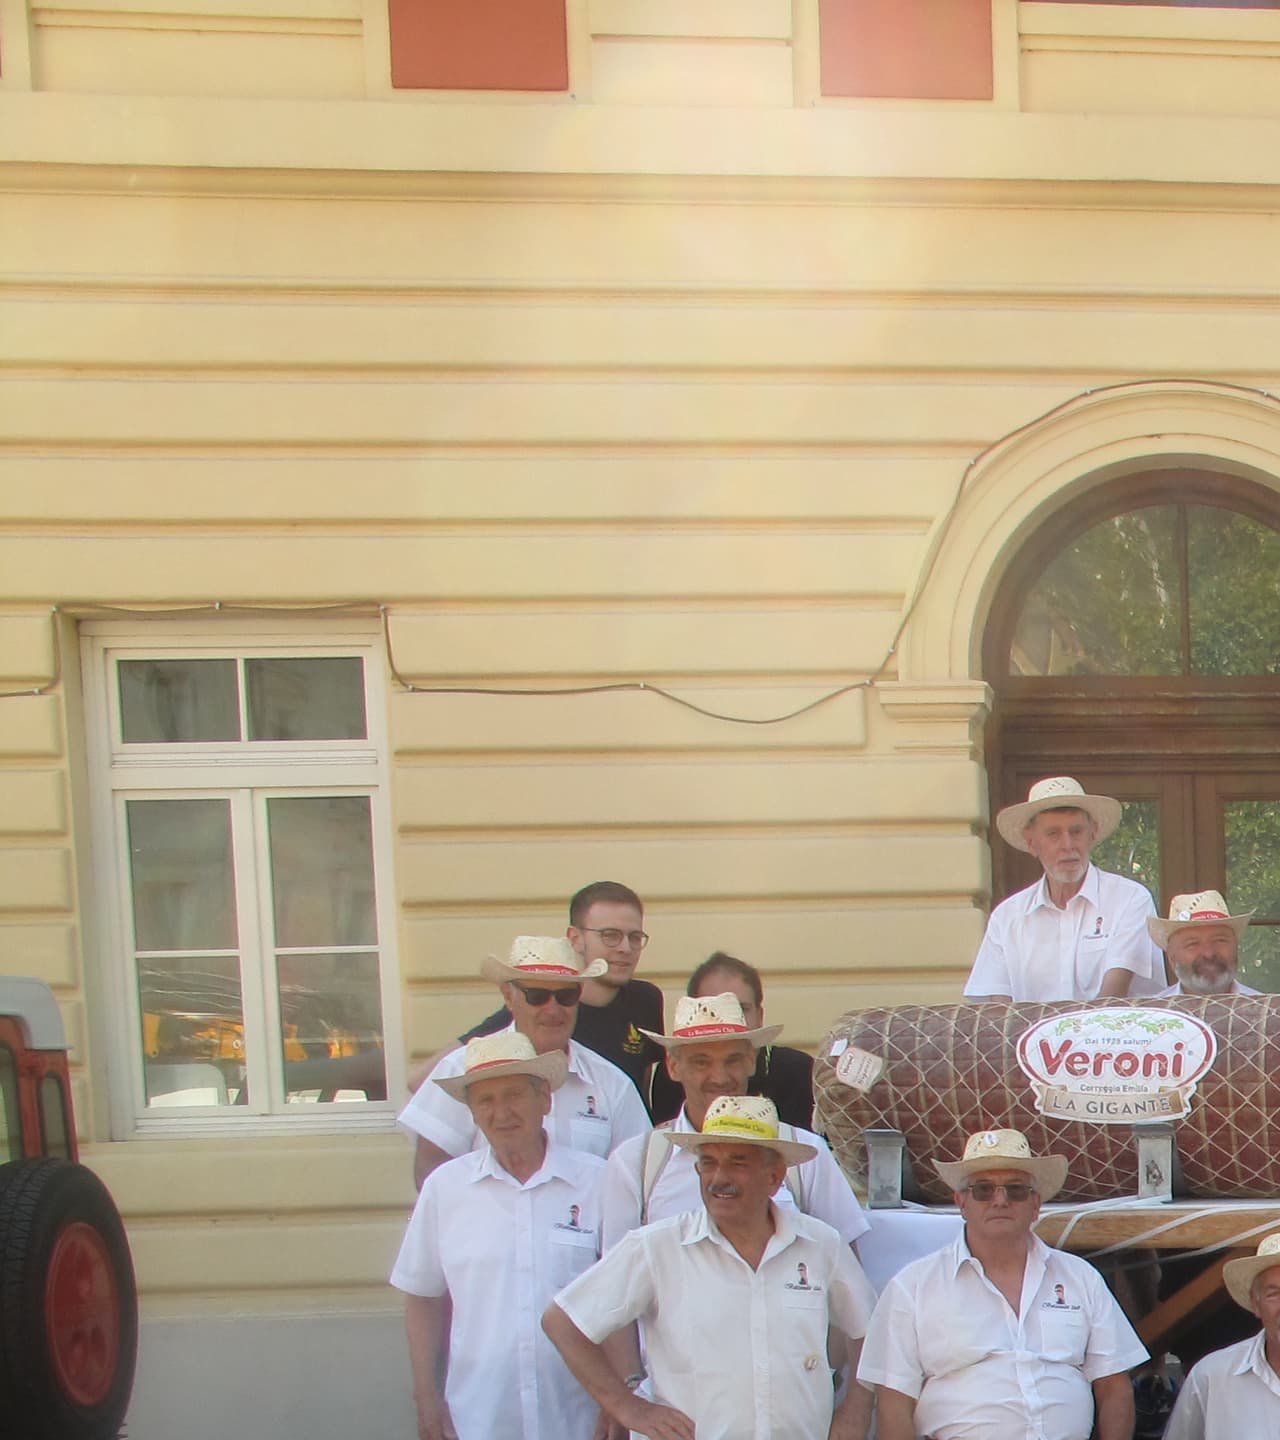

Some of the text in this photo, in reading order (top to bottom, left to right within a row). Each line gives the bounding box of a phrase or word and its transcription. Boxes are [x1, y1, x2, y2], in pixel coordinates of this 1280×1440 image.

[1039, 1038, 1184, 1078] Veroni
[1053, 1095, 1171, 1116] LA GIGANTE
